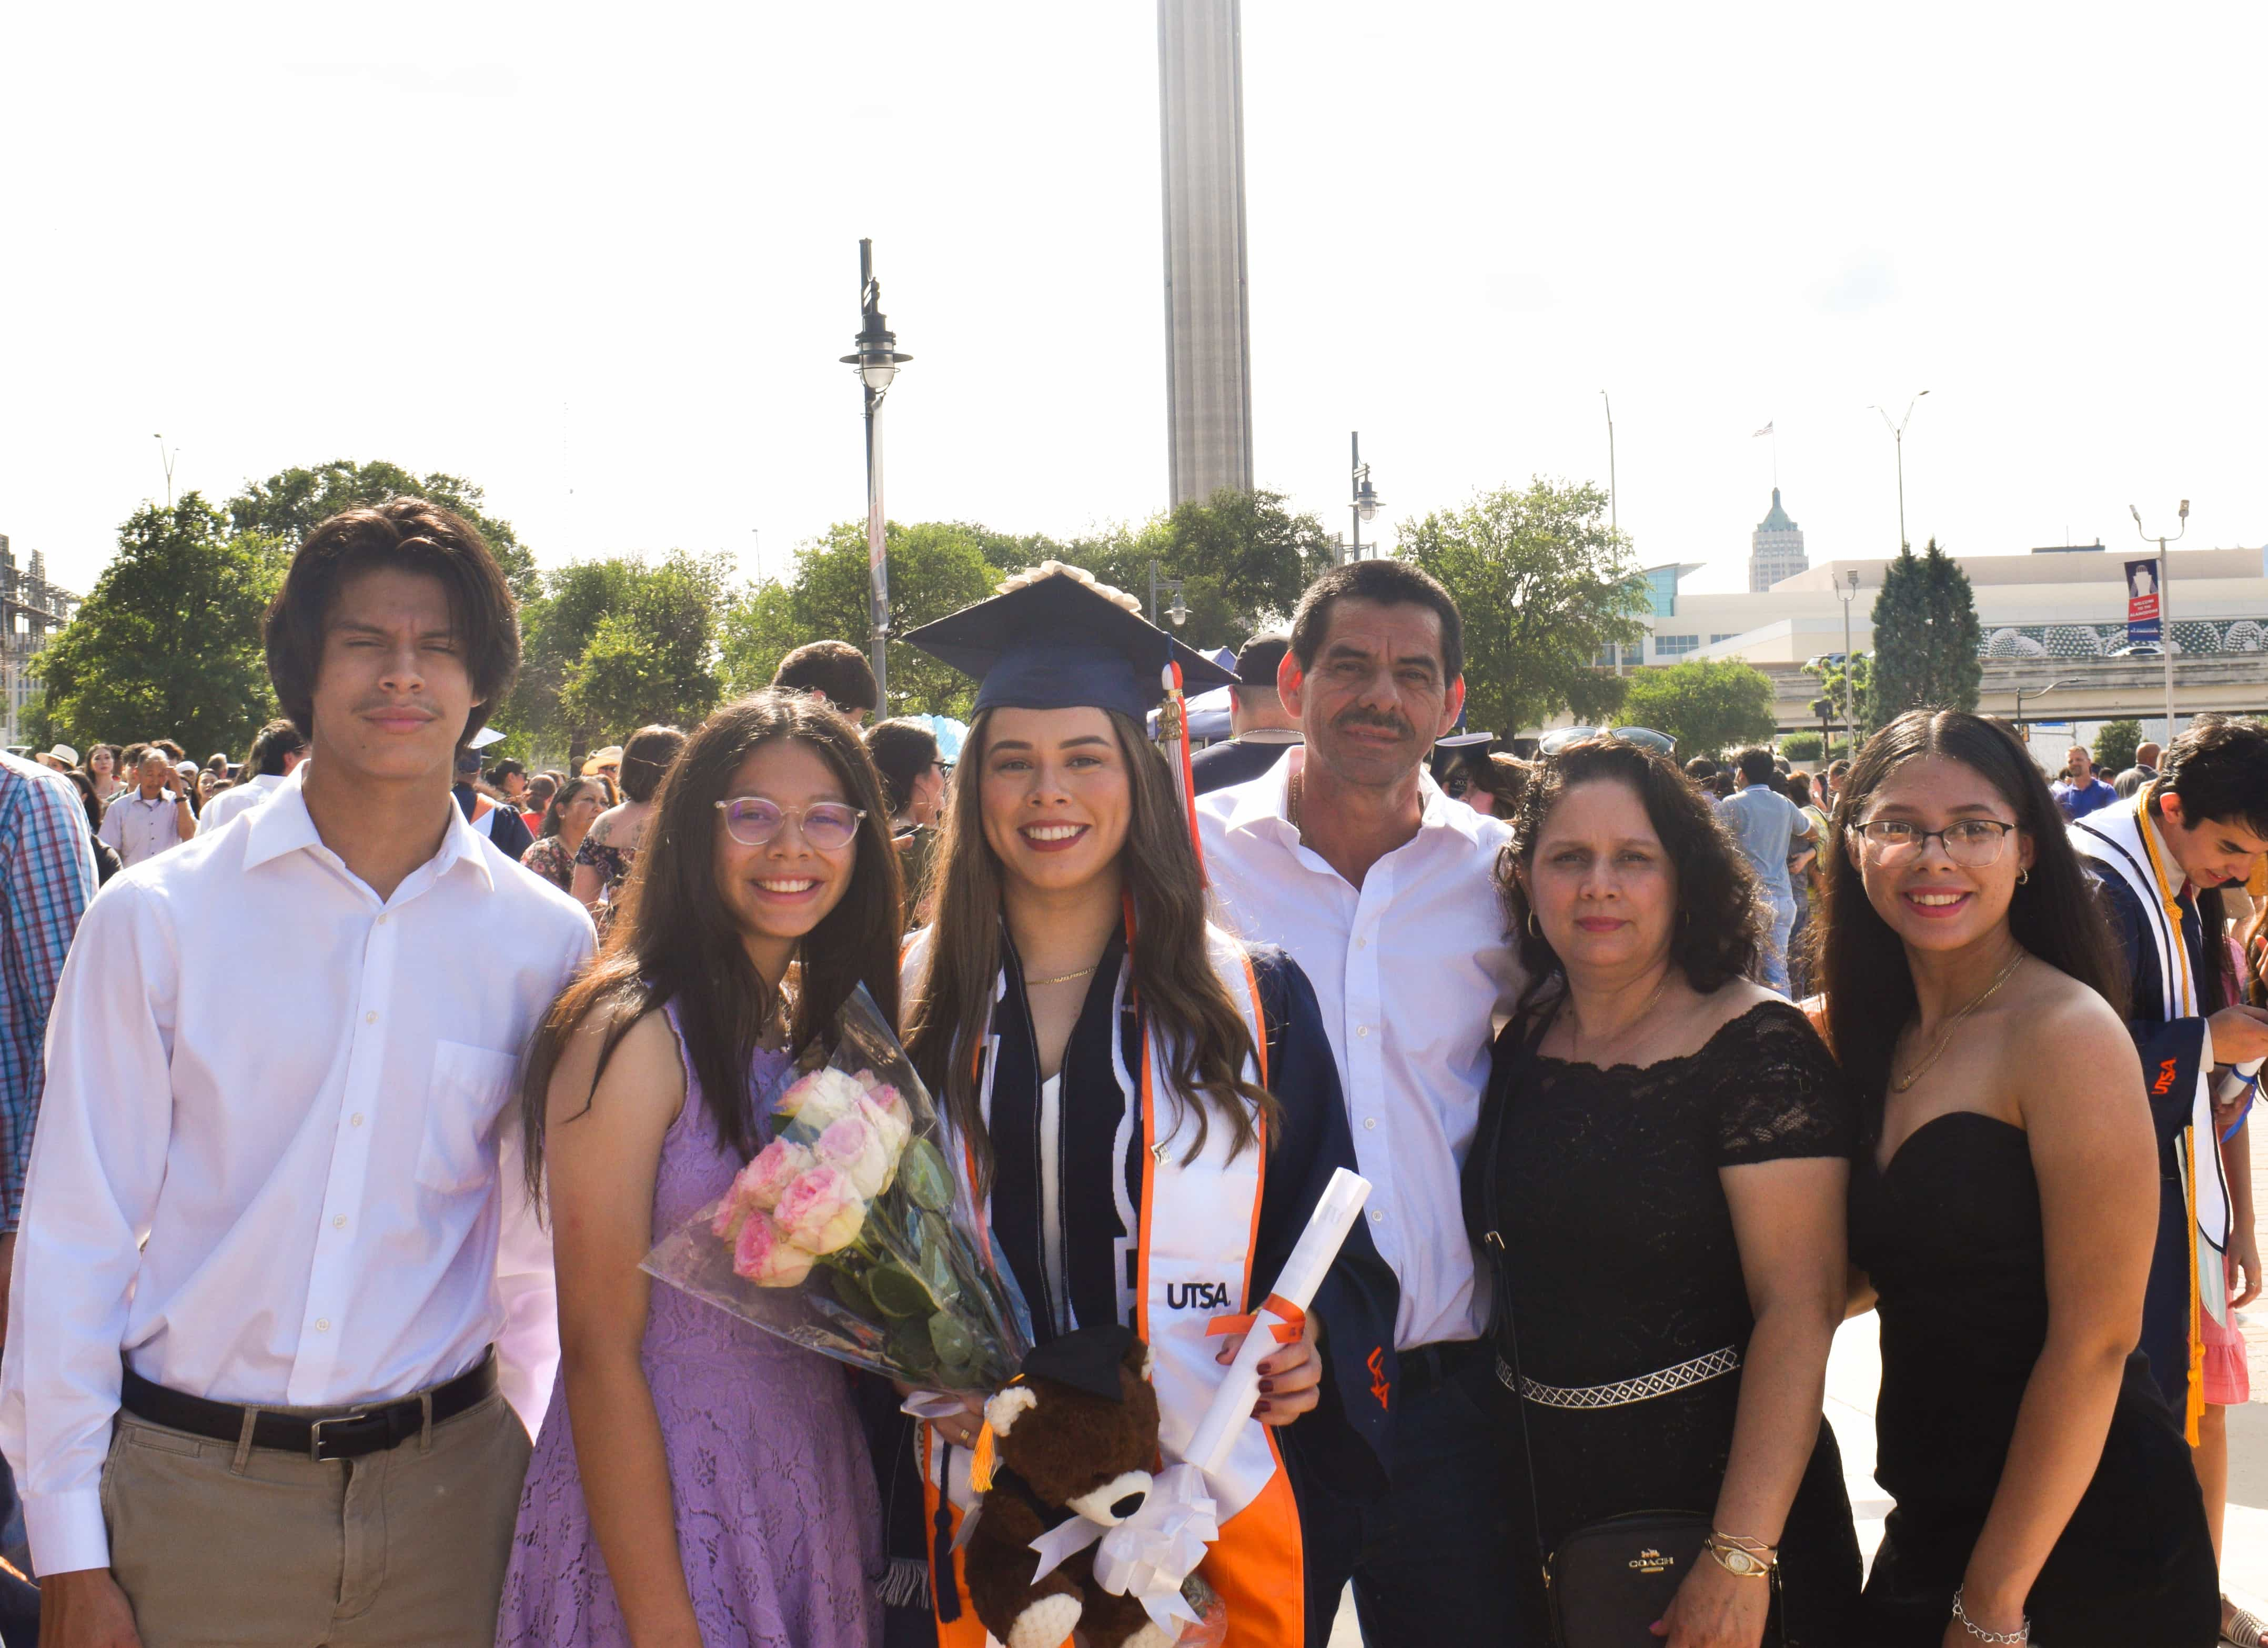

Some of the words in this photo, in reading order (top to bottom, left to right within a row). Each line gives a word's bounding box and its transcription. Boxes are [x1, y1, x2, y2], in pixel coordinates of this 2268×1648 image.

[2151, 1057, 2177, 1095] UTSA
[1167, 1282, 1229, 1310] UTSA
[1628, 1556, 1674, 1568] COACH
